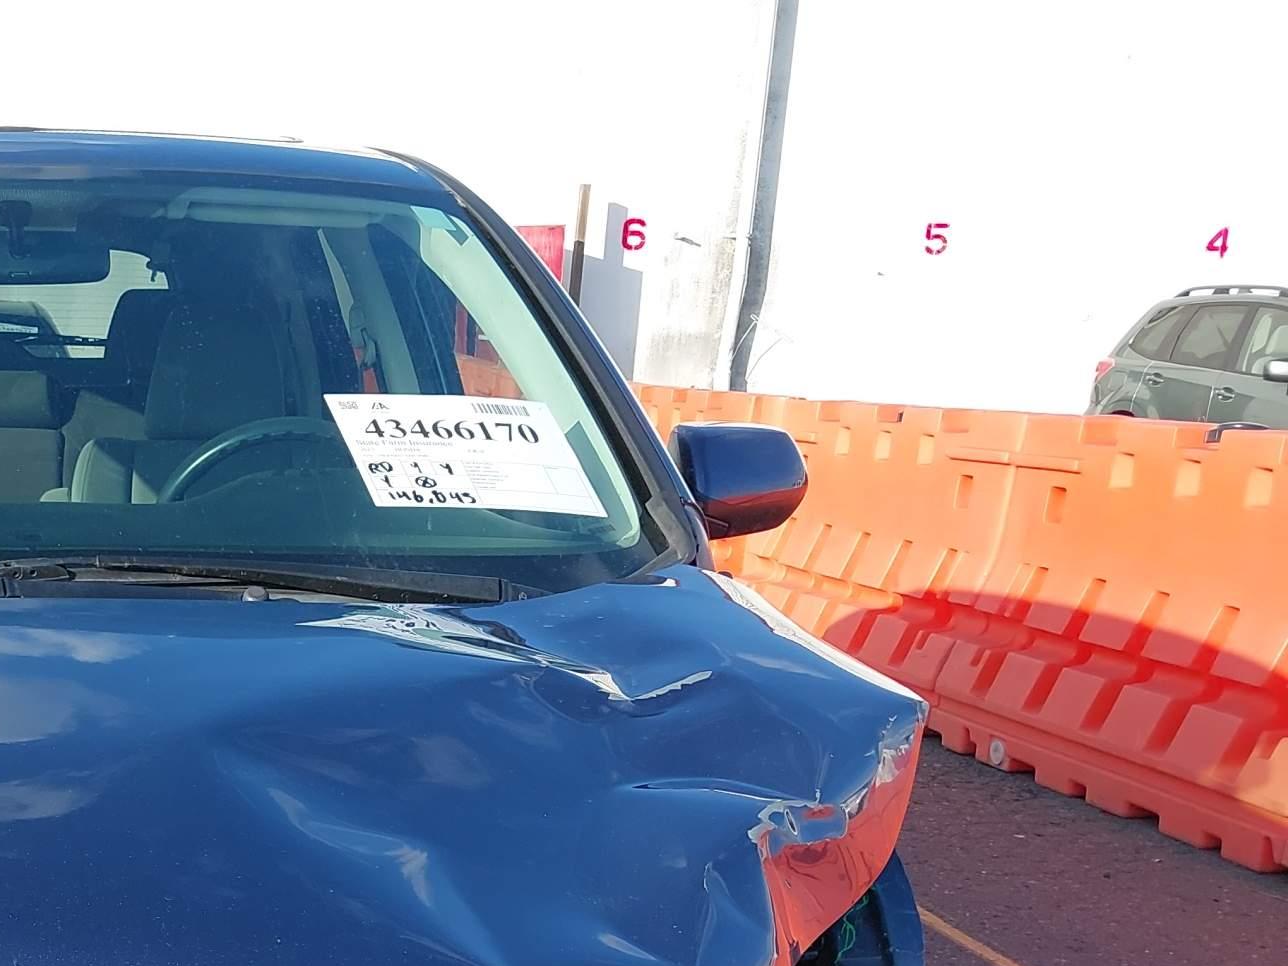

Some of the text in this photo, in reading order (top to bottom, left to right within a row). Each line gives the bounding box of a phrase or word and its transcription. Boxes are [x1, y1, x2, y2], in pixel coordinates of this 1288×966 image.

[621, 217, 647, 251] 6
[924, 222, 951, 255] 5
[1206, 227, 1230, 257] 4
[365, 418, 539, 444] 43466170
